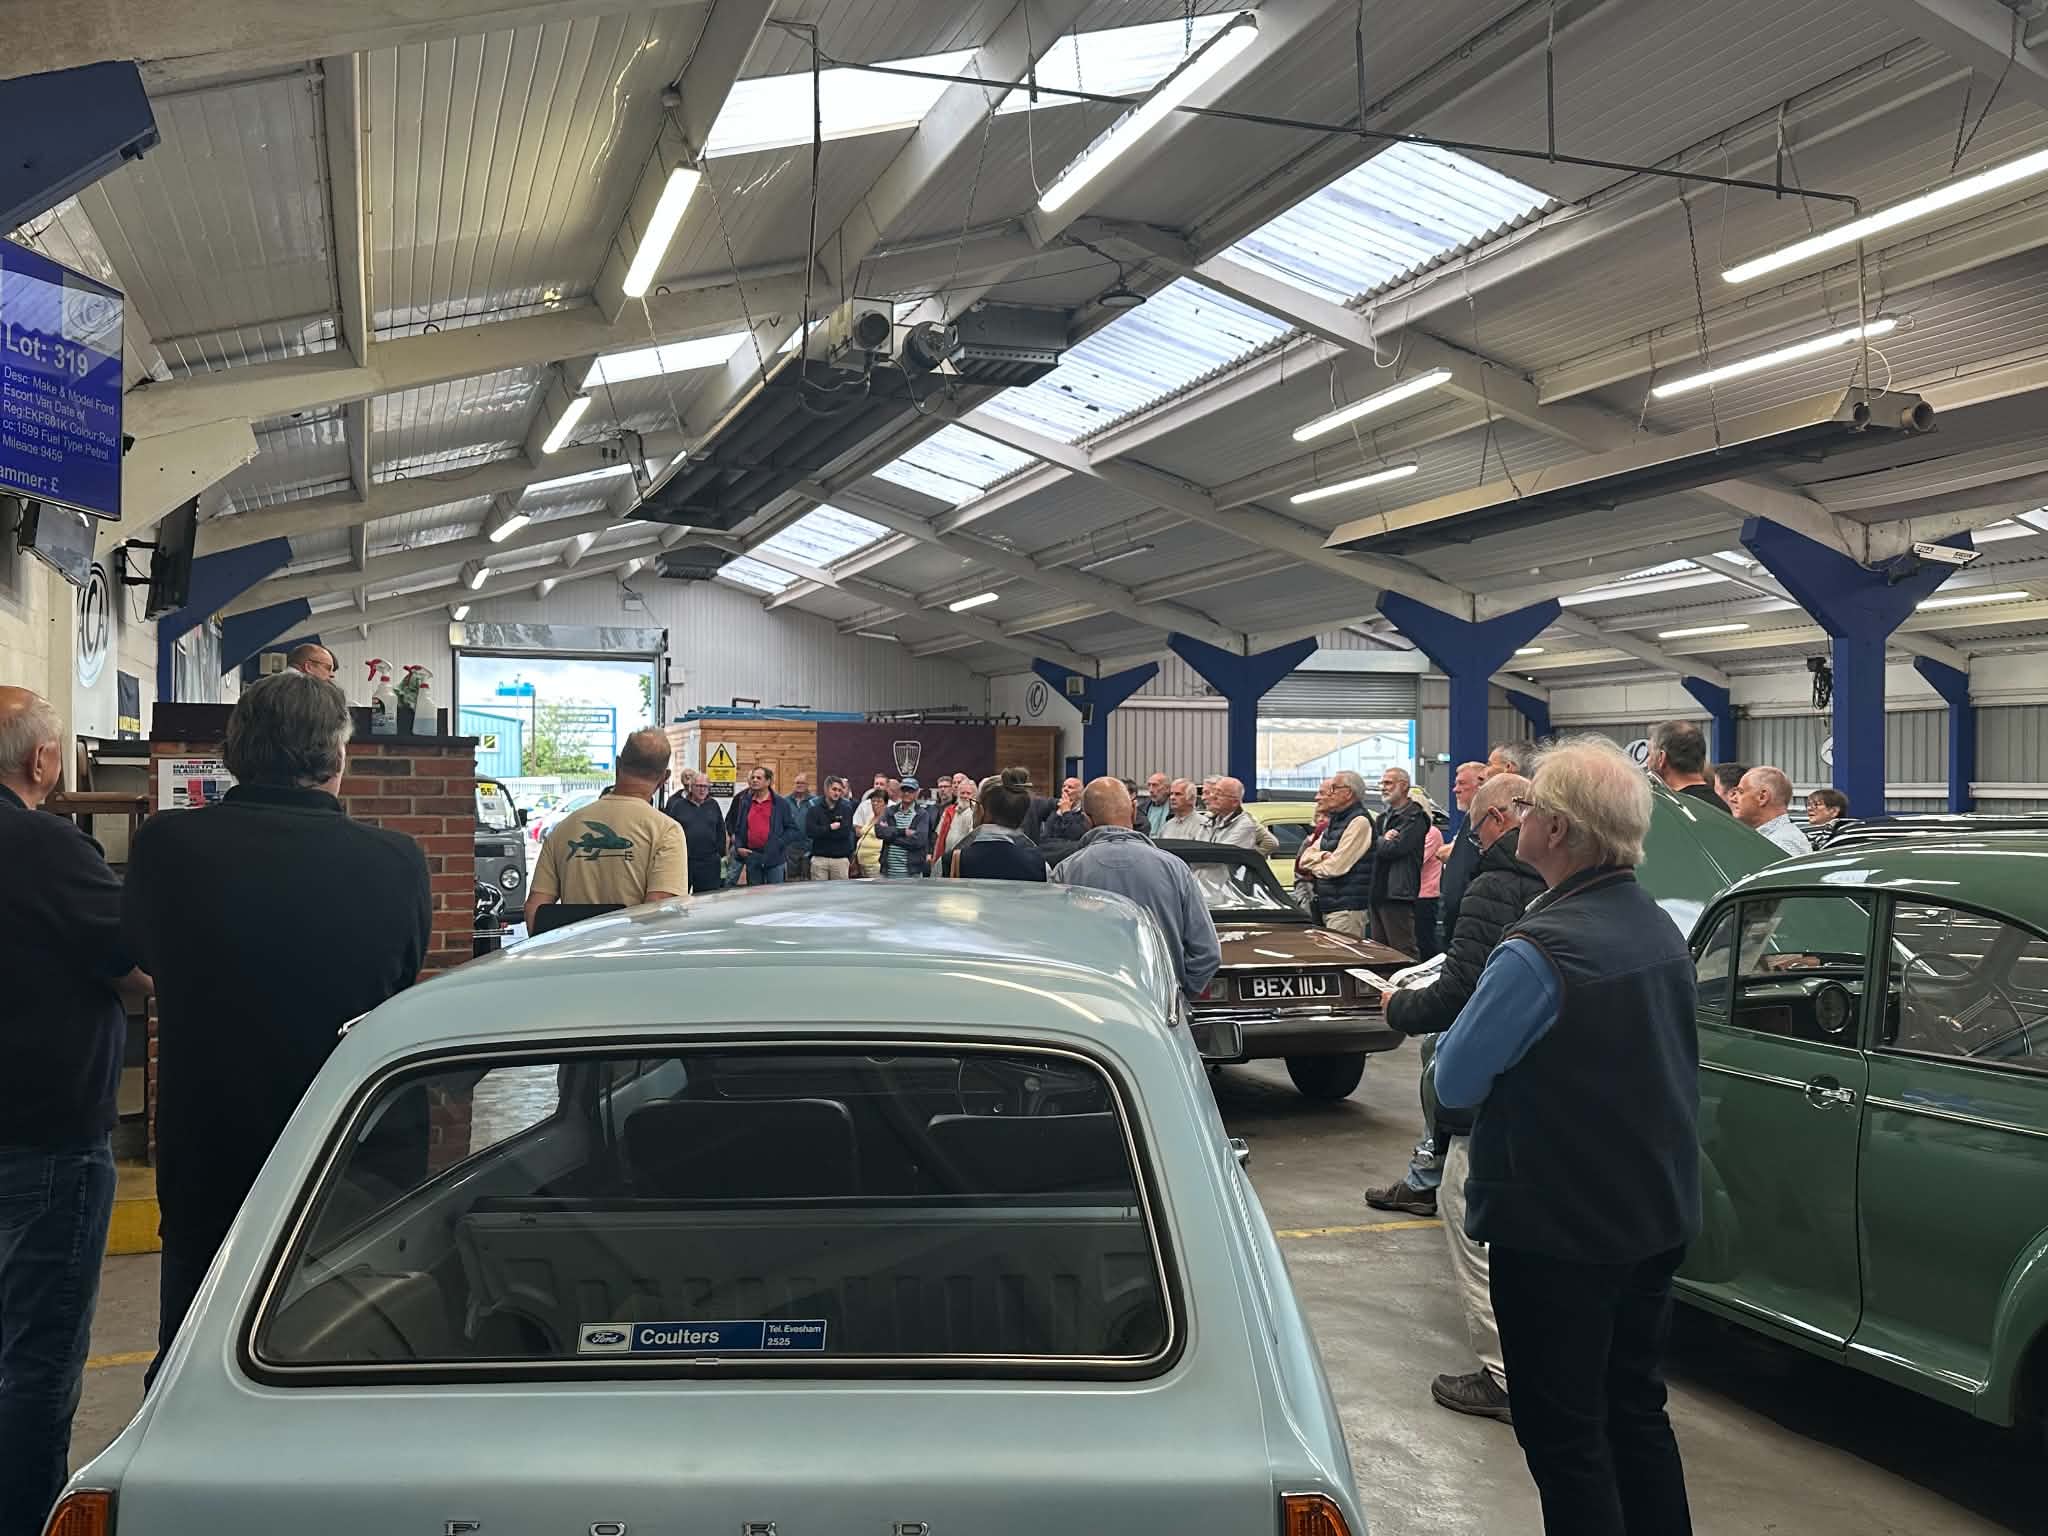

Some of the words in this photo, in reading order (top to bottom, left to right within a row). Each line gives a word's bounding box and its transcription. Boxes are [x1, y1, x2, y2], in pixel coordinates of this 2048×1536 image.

[6, 322, 46, 363] Lot:
[54, 343, 88, 377] 319
[32, 375, 57, 394] Make
[3, 382, 33, 403] Escort
[54, 400, 75, 417] Date
[41, 428, 61, 445] Fuel
[50, 477, 59, 493] £
[1253, 977, 1294, 997] BEX
[591, 1332, 619, 1344] Ford
[640, 1328, 720, 1344] Coulters
[768, 1337, 791, 1346] 2525
